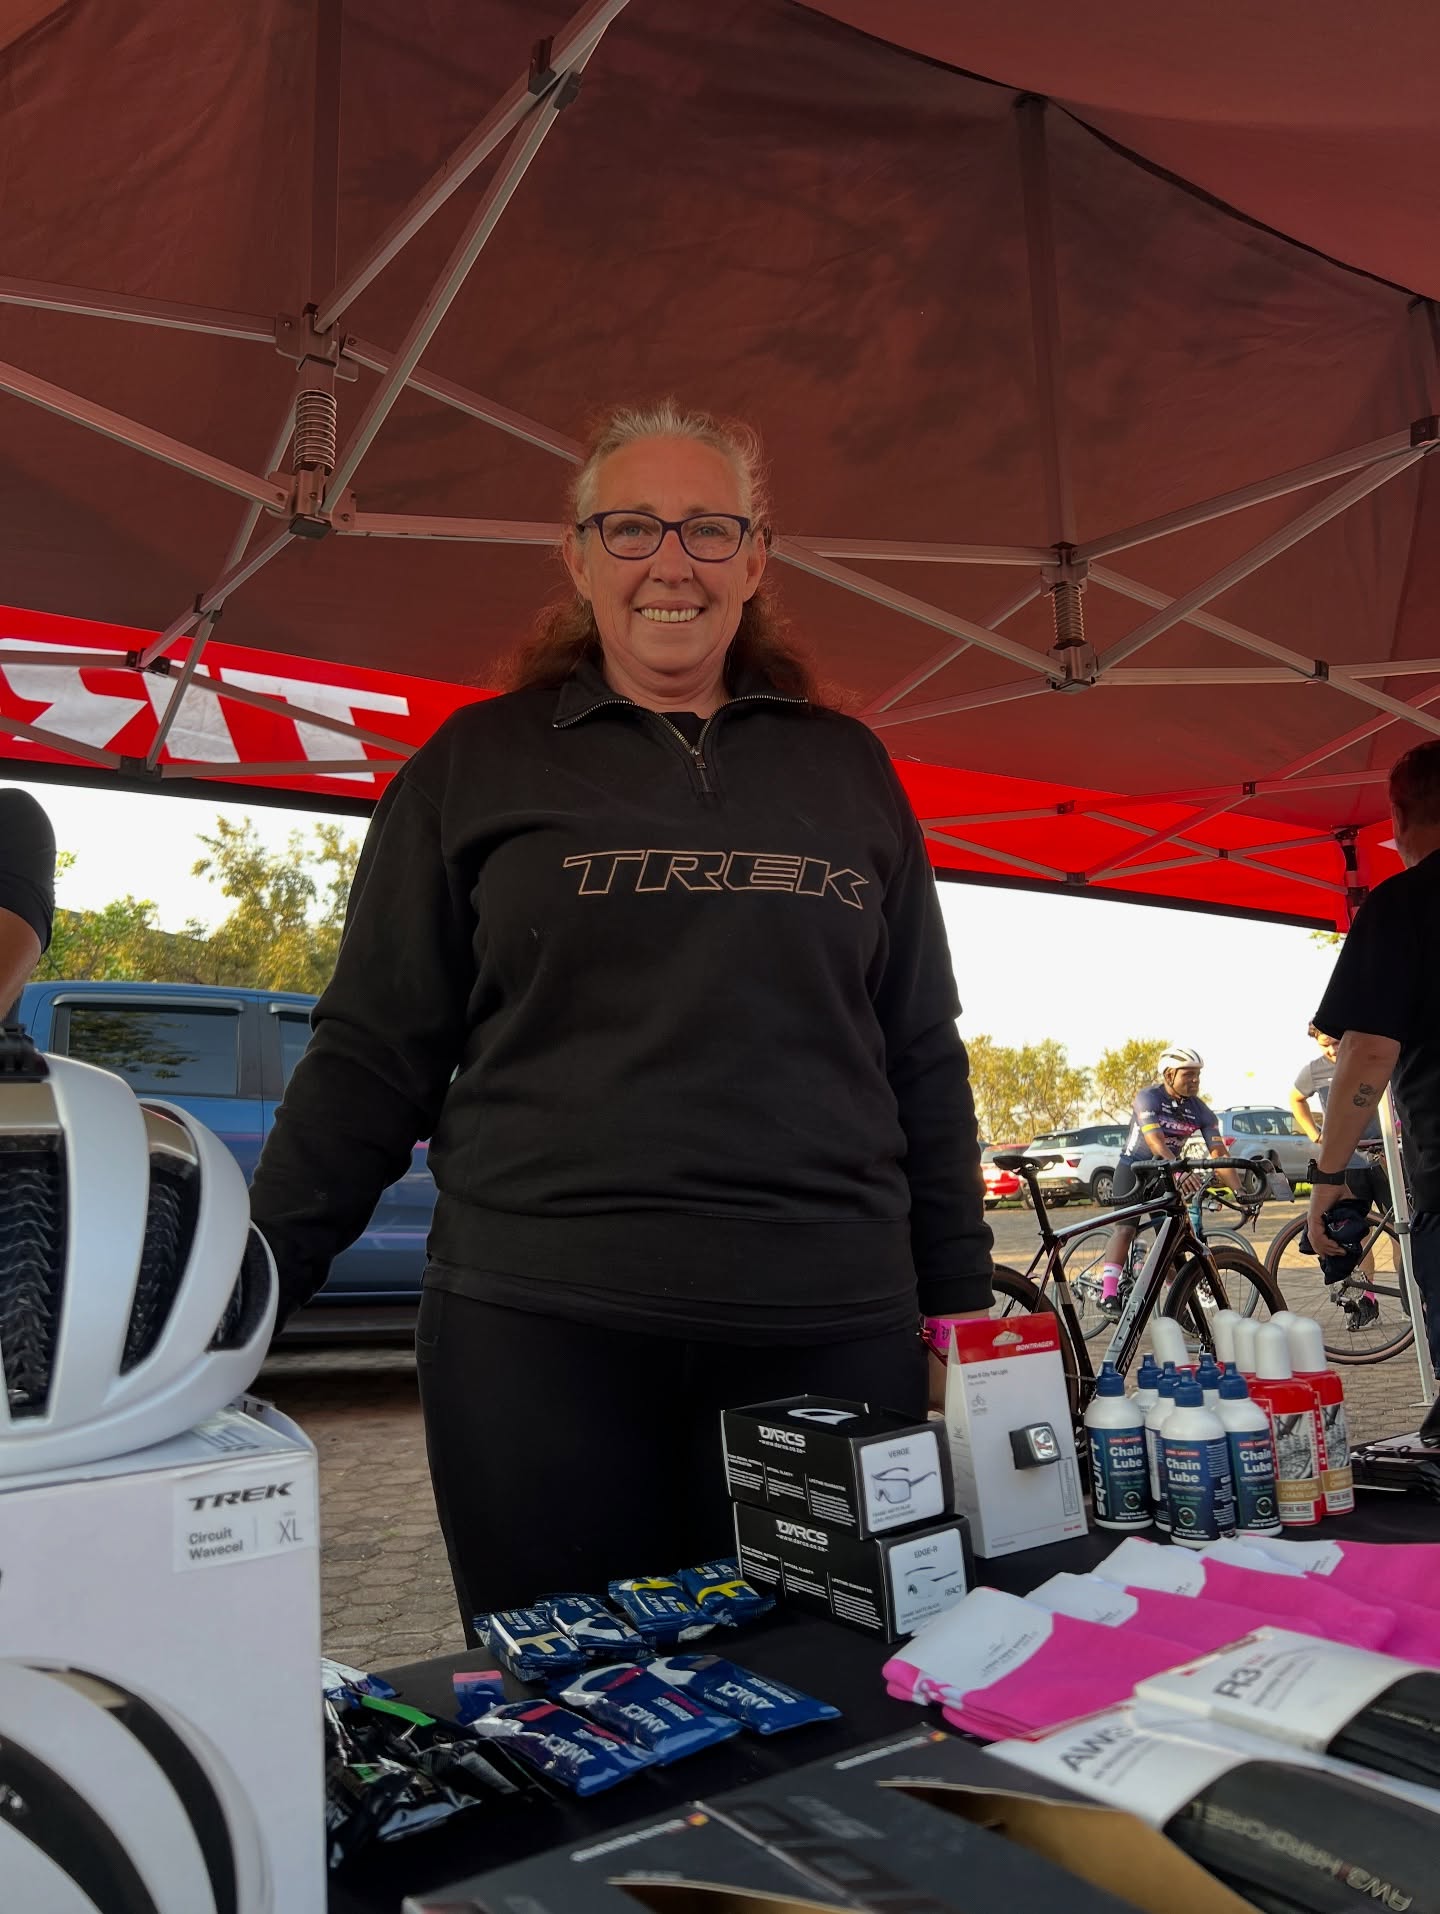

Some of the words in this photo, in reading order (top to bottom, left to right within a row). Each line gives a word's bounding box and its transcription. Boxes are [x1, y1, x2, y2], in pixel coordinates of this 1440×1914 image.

[563, 849, 869, 910] TREK
[1015, 1340, 1054, 1351] BONTRAGER
[758, 1425, 806, 1448] DARCS
[888, 1447, 910, 1459] VERGE
[1109, 1446, 1143, 1457] Chain
[1240, 1449, 1272, 1461] Chain
[1113, 1458, 1143, 1469] Lube
[1165, 1457, 1201, 1470] Chain
[1244, 1462, 1273, 1473] Lube
[1090, 1437, 1107, 1516] squirt
[1168, 1470, 1200, 1483] Lube
[186, 1481, 295, 1512] TREK
[189, 1527, 233, 1546] Circuit
[279, 1517, 303, 1545] XL
[775, 1519, 829, 1546] DARCS
[189, 1540, 244, 1561] Wavecel
[914, 1545, 938, 1559] EDGE-R
[1212, 1668, 1262, 1699] R3
[716, 1681, 776, 1710] AMACX
[619, 1703, 672, 1734] AMACX
